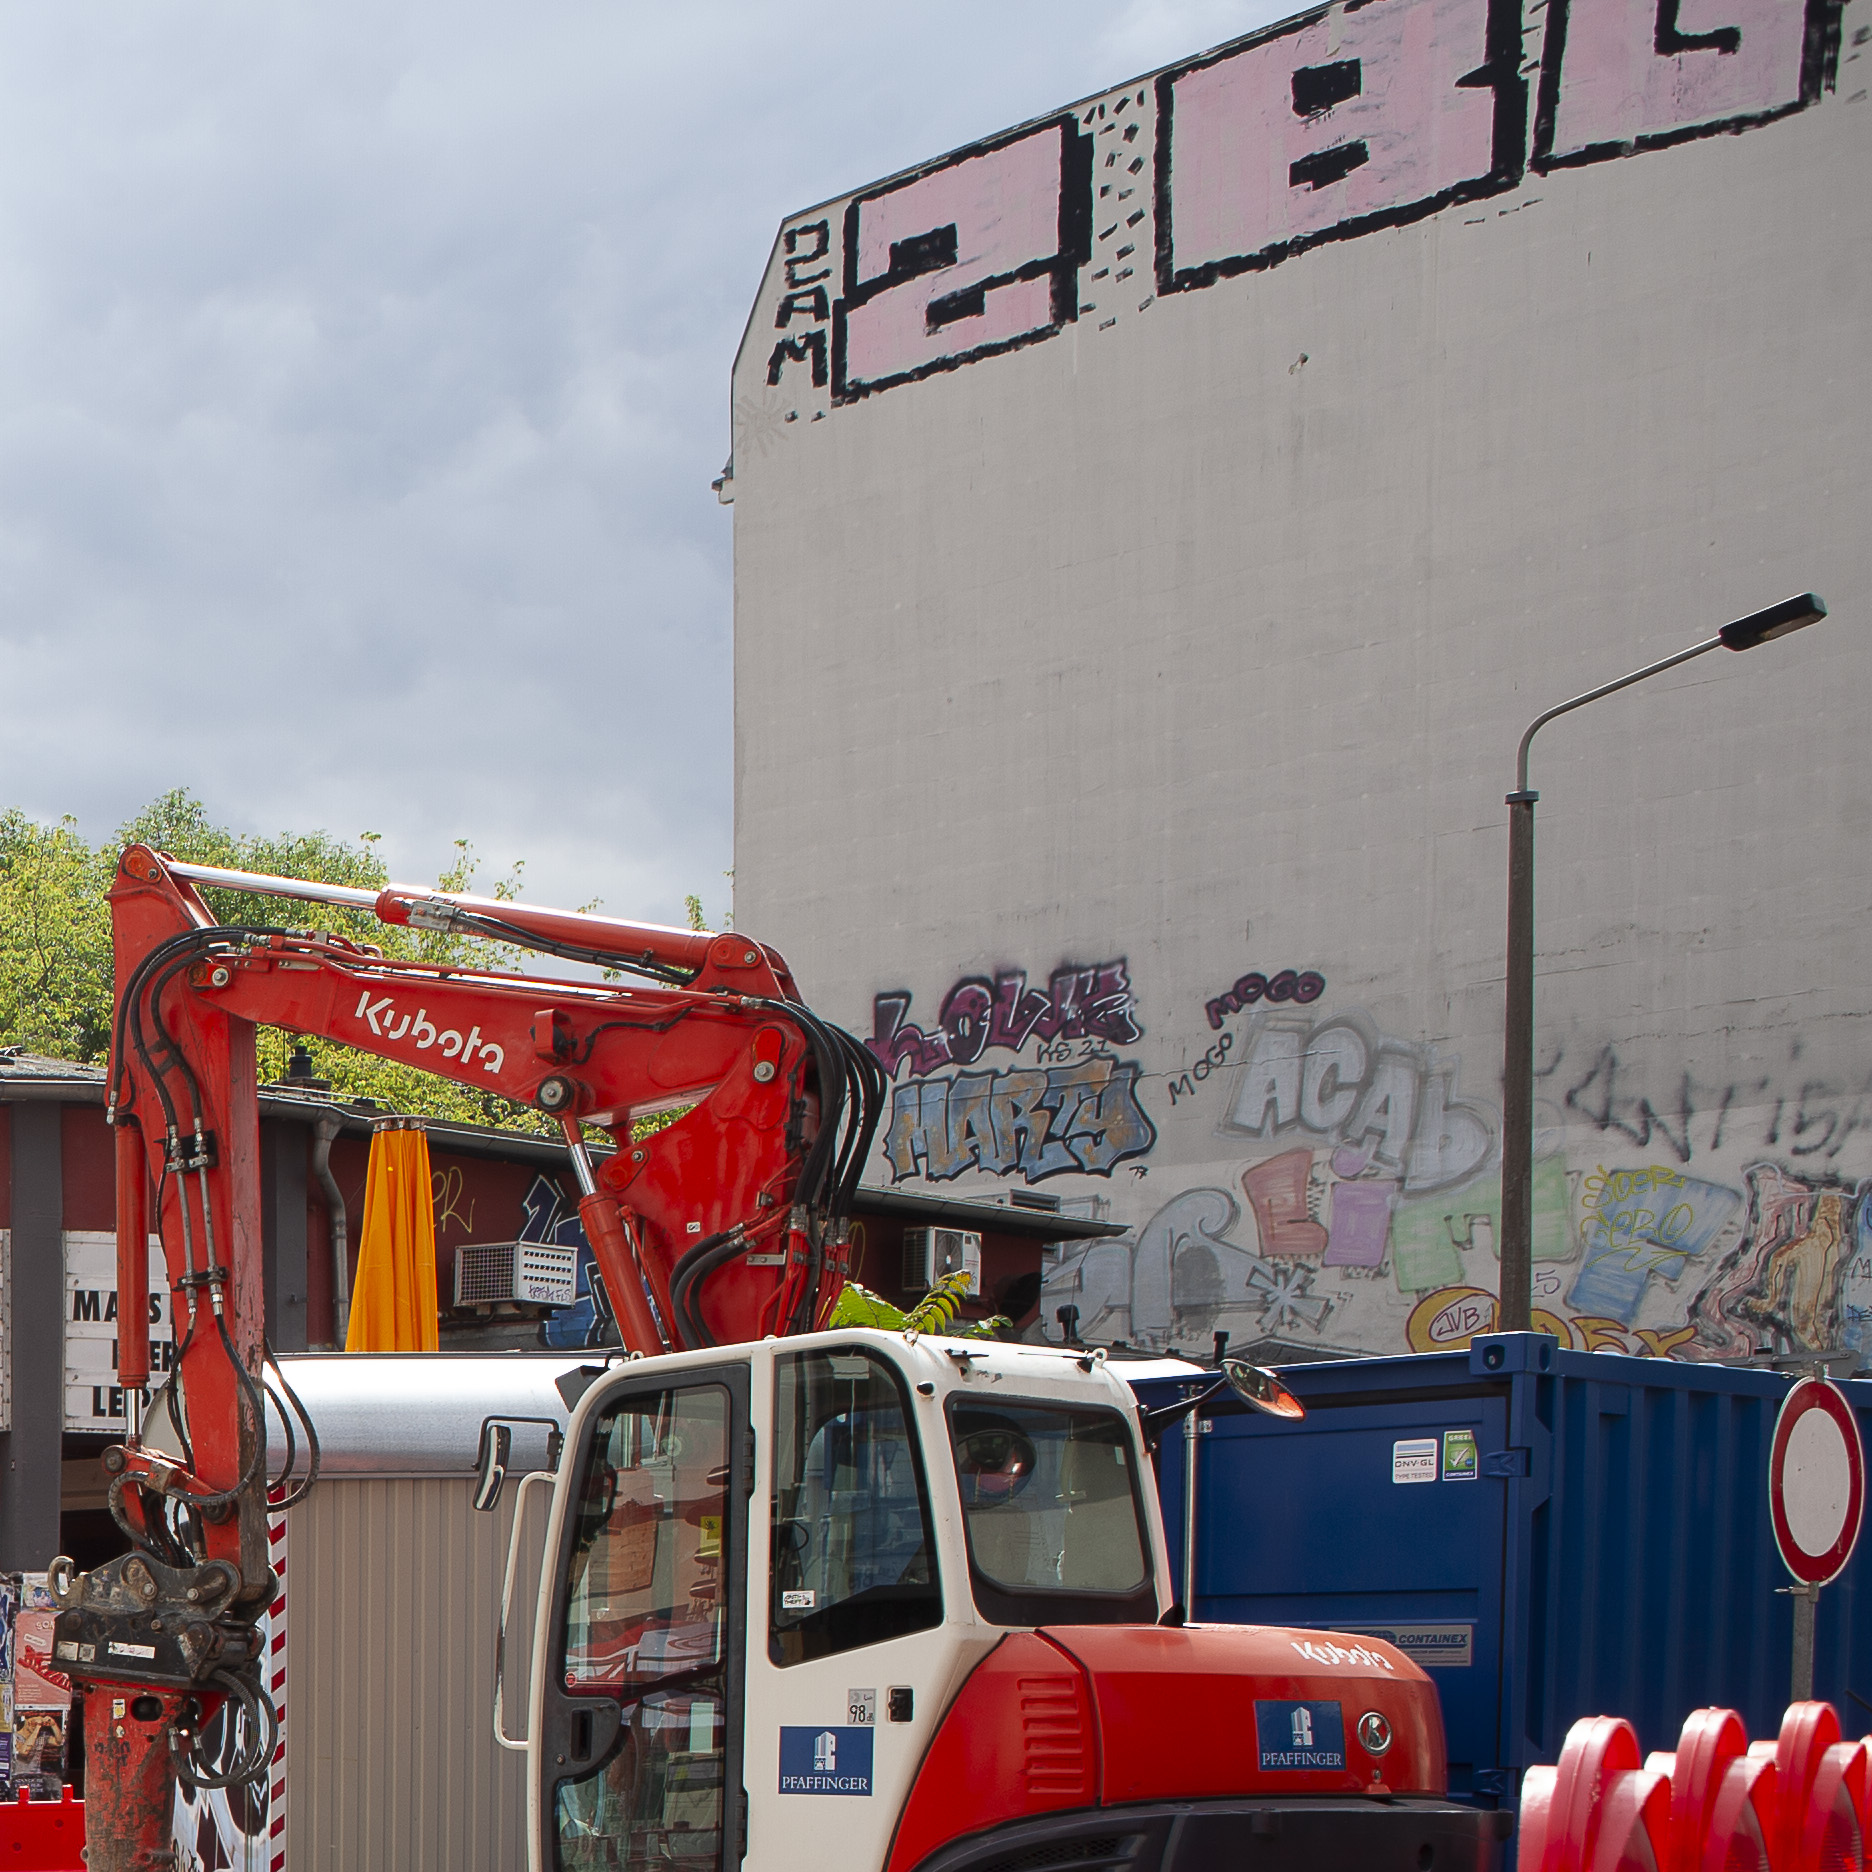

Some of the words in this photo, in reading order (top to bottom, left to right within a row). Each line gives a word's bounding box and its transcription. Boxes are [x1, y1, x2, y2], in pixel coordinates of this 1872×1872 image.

[355, 990, 505, 1075] Kubota
[882, 1055, 1158, 1186] MARTY
[1398, 1634, 1468, 1644] CONTAINEX
[1290, 1640, 1395, 1671] Kubota
[849, 1704, 867, 1723] 98
[1262, 1751, 1342, 1766] PFAFFINGER
[781, 1775, 868, 1791] PFAFFINGER
